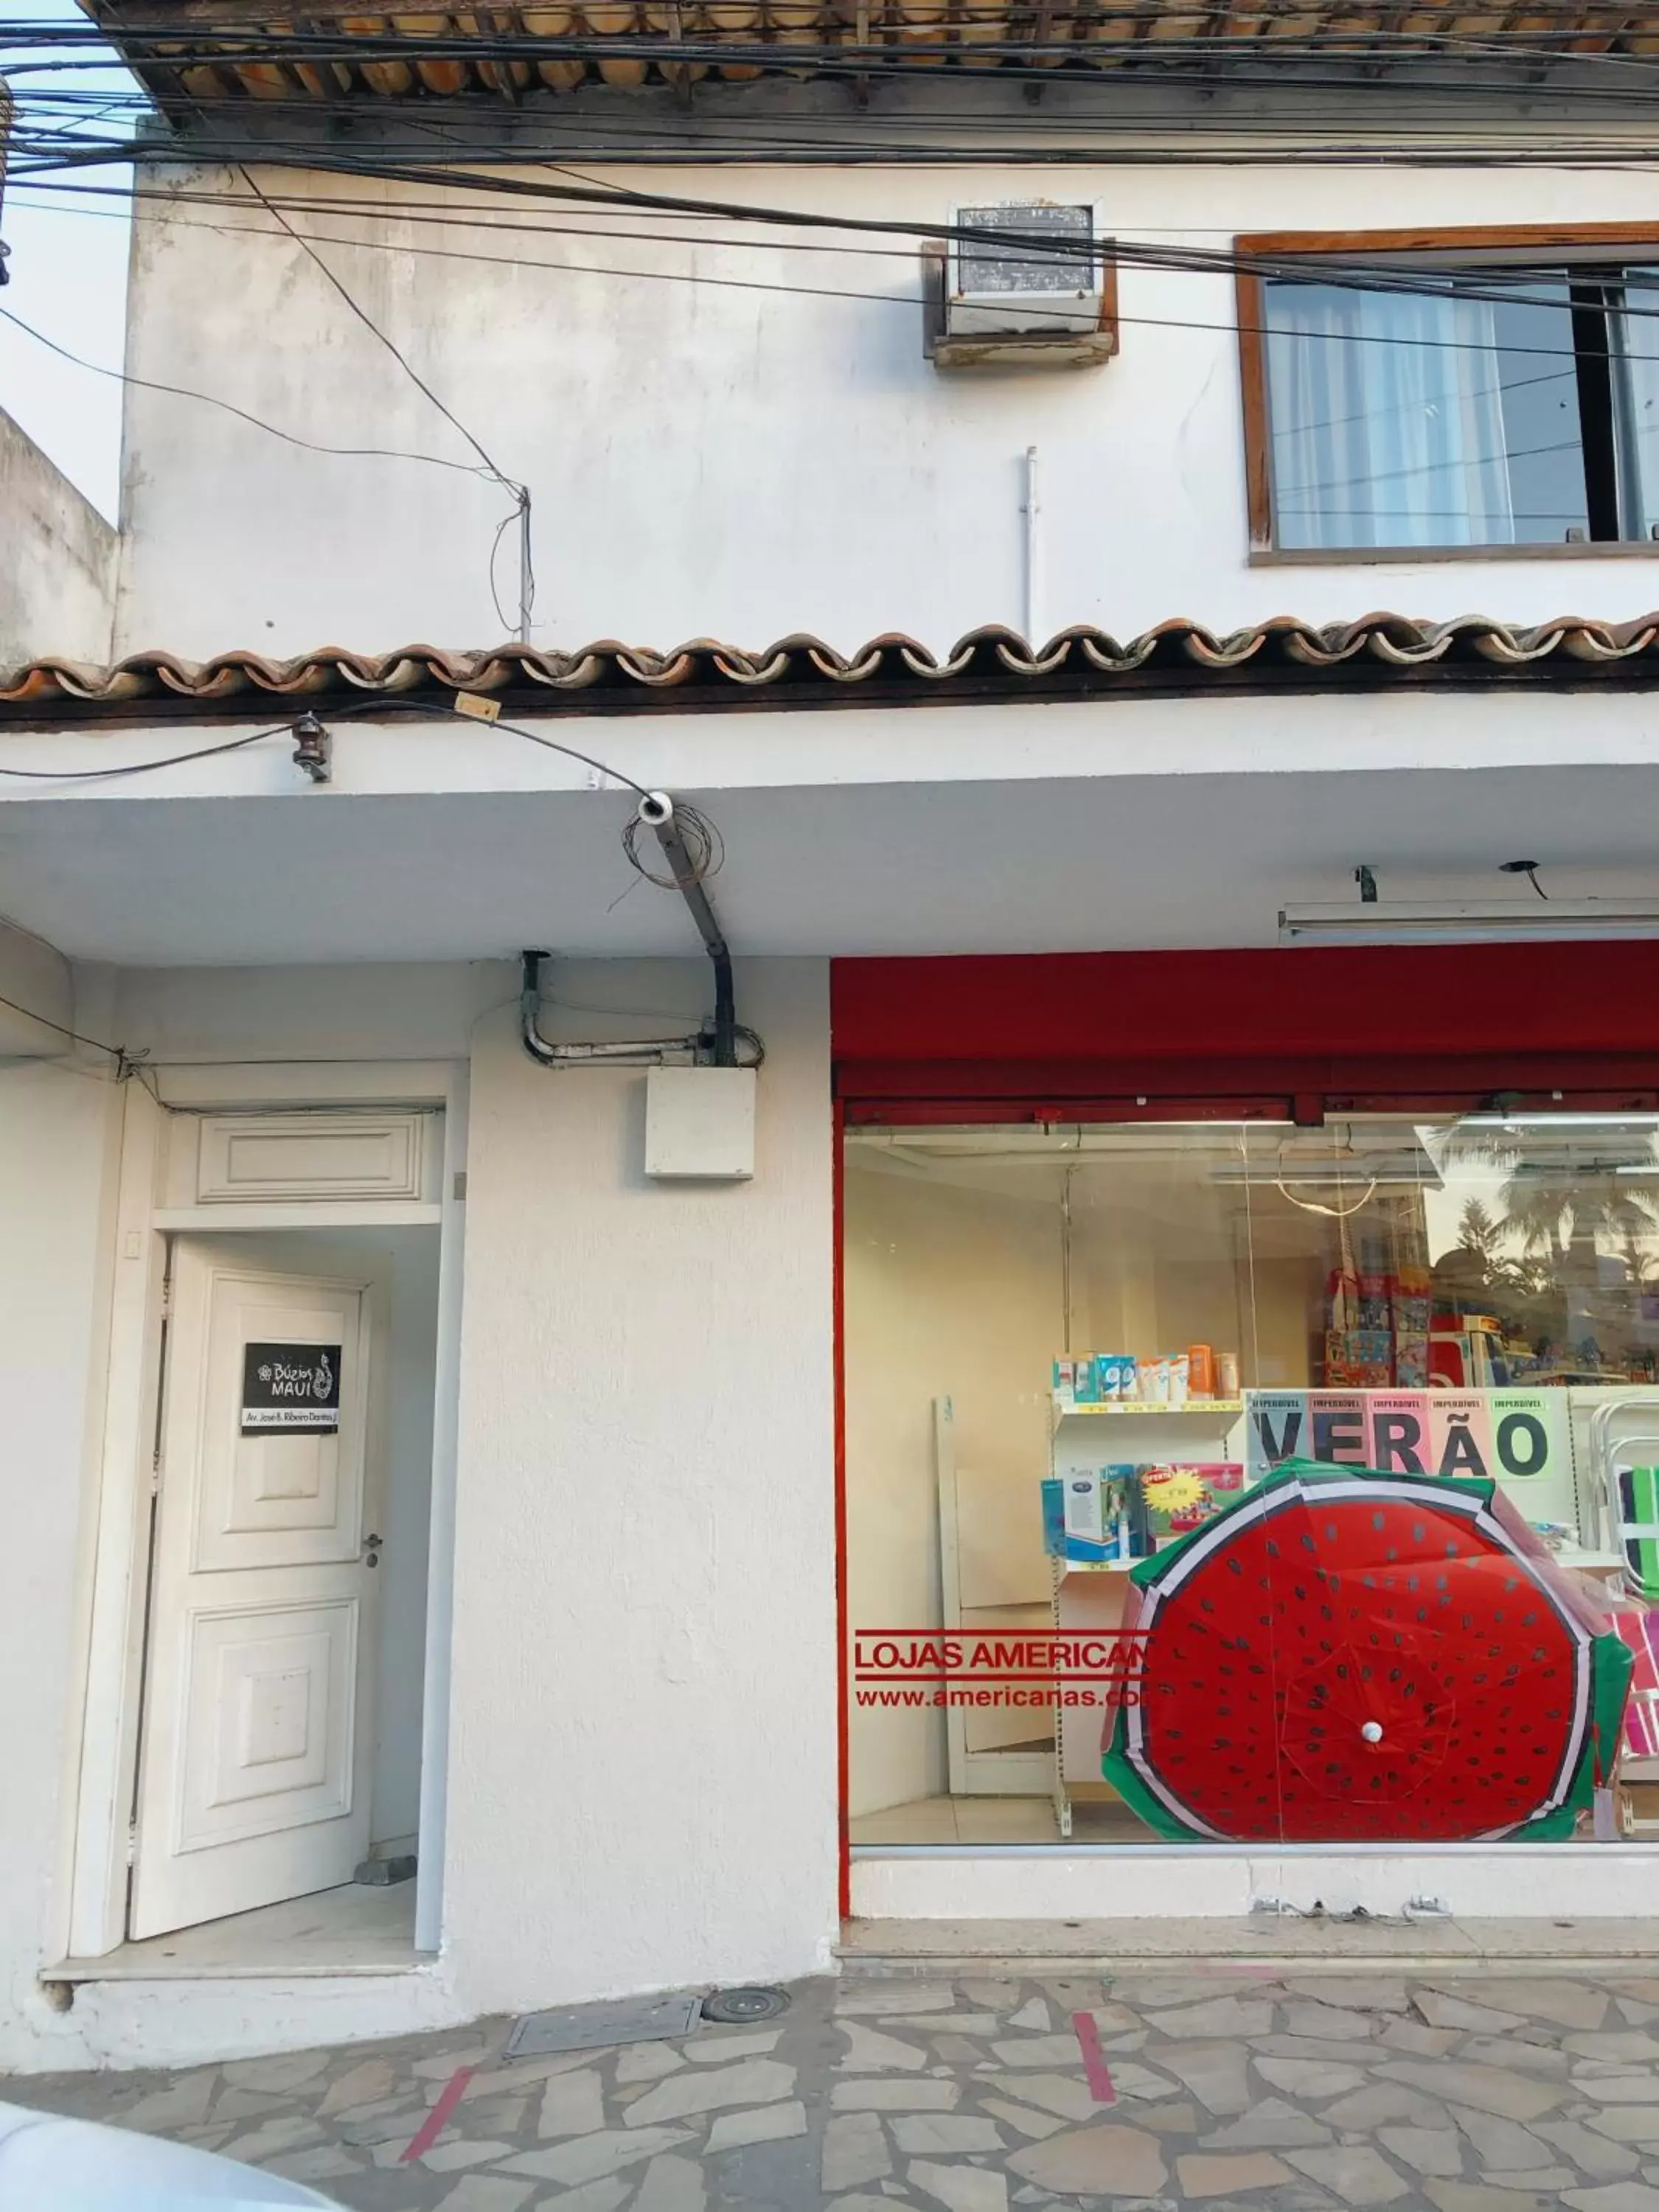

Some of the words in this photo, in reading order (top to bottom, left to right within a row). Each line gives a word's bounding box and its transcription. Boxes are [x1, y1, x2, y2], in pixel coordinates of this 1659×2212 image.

[274, 1363, 312, 1381] Búzios
[271, 1382, 310, 1397] MAUI
[1253, 1413, 1548, 1477] VERÃO
[855, 1642, 963, 1669] LOJAS
